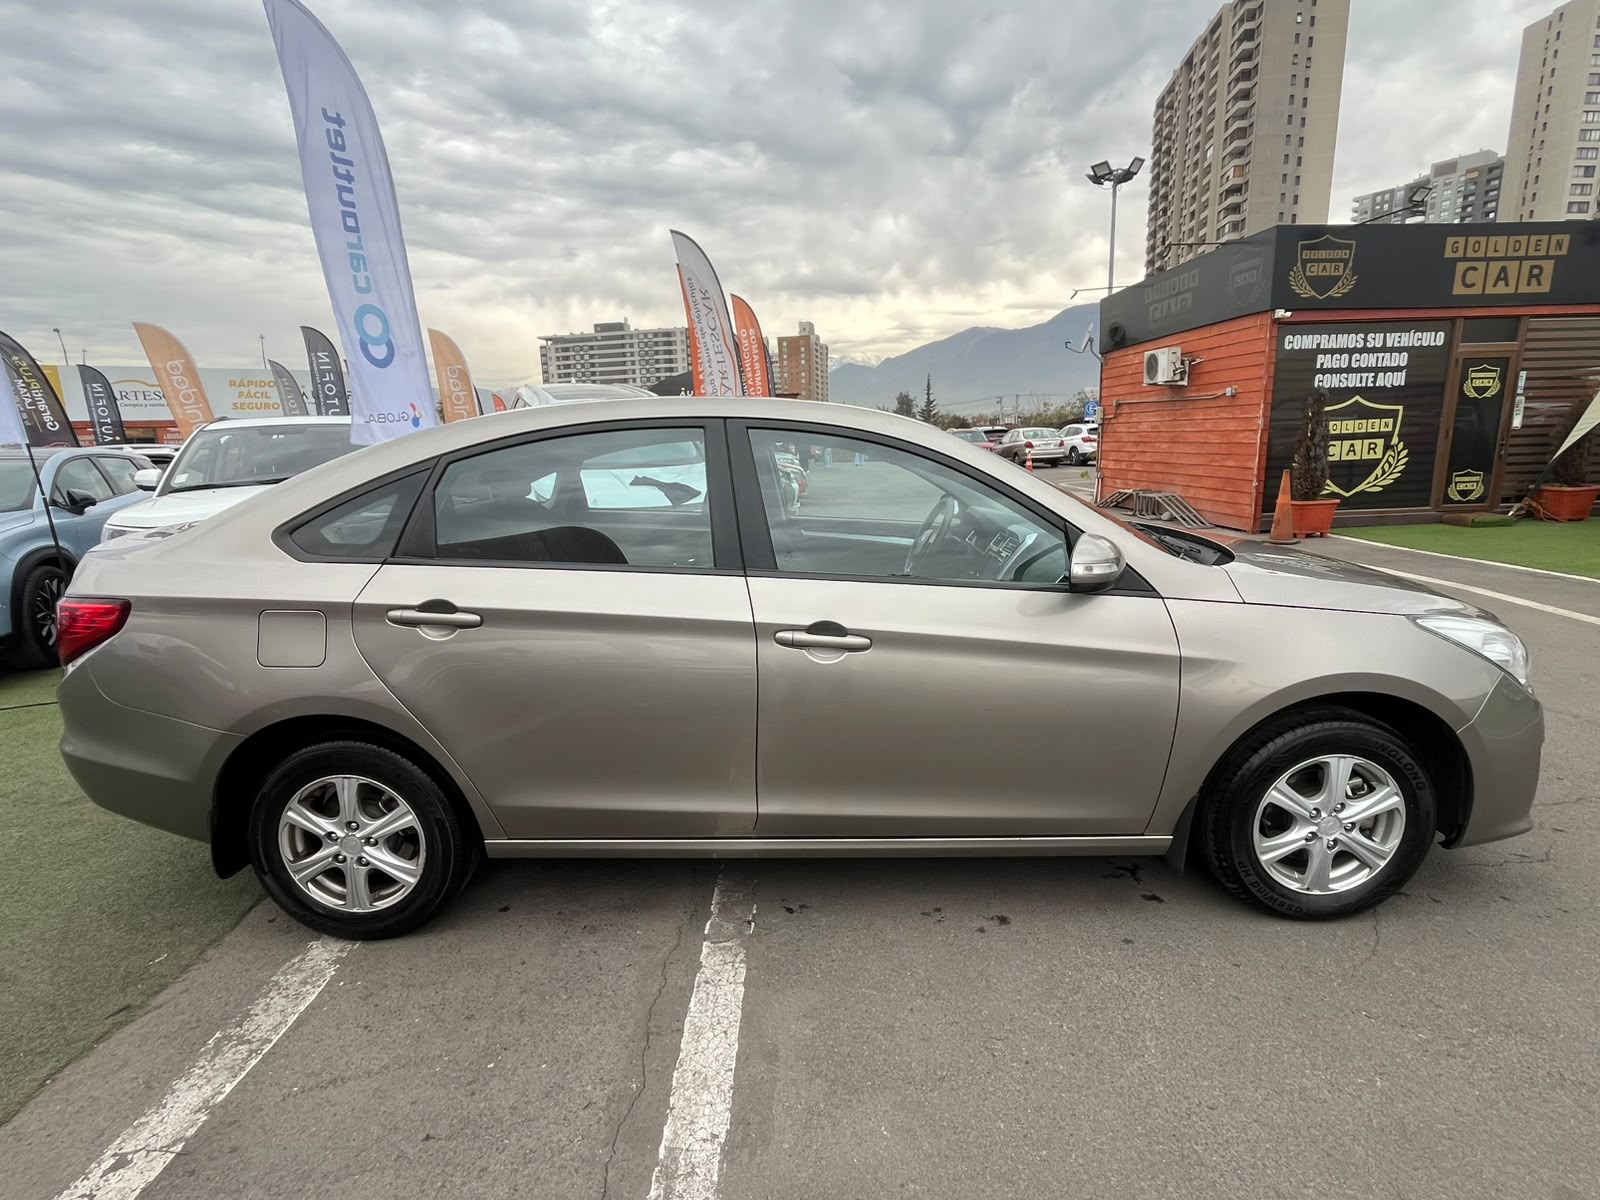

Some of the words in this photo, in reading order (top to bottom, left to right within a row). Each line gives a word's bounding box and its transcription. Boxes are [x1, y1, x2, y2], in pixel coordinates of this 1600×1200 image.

[1450, 238, 1564, 255] GOLDEN
[1307, 262, 1343, 275] CAR
[1460, 262, 1546, 289] CAR
[1284, 333, 1364, 350] COMPRAMOS
[1366, 332, 1384, 348] SU
[1386, 329, 1445, 347] VEHÍCULO
[1316, 353, 1349, 369] PAGO
[1351, 352, 1408, 368] CONTADO
[229, 377, 275, 388] RÁPIDO
[1314, 372, 1375, 389] CONSULTE
[1376, 369, 1407, 387] AQUÍ
[117, 390, 166, 401] RTES
[238, 390, 271, 399] FÁCIL
[232, 402, 280, 411] SEGURO
[1329, 420, 1392, 433] OLDEN
[1328, 441, 1378, 457] CAR
[1374, 741, 1426, 791] INGLONG
[1248, 880, 1304, 913] ossWind
